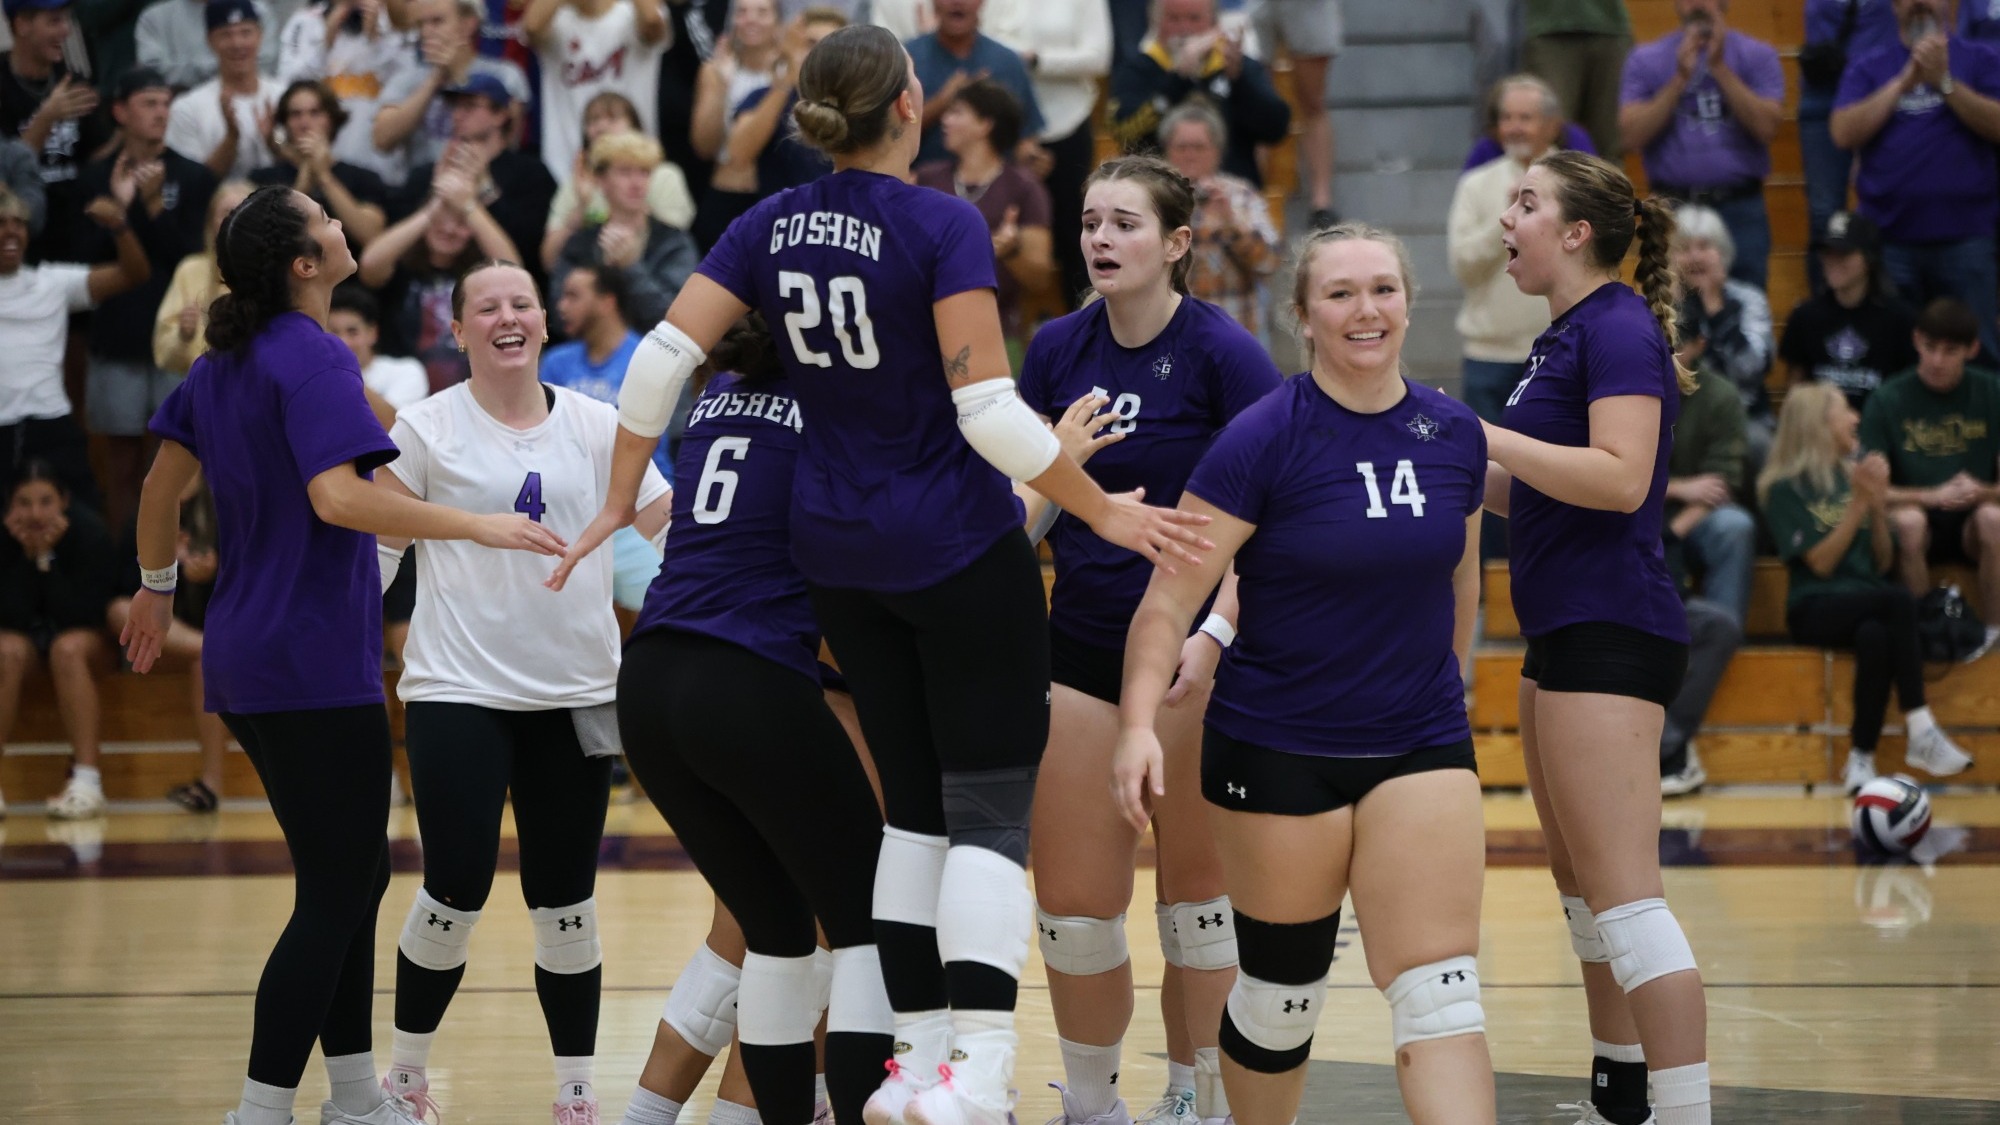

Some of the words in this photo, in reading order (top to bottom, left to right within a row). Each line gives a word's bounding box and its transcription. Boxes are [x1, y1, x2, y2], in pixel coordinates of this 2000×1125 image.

[770, 211, 882, 262] GOSHEN
[778, 270, 880, 370] 20
[688, 392, 804, 434] GOSHEN
[514, 471, 547, 524] 4
[692, 436, 752, 525] 6
[1356, 459, 1427, 518] 14
